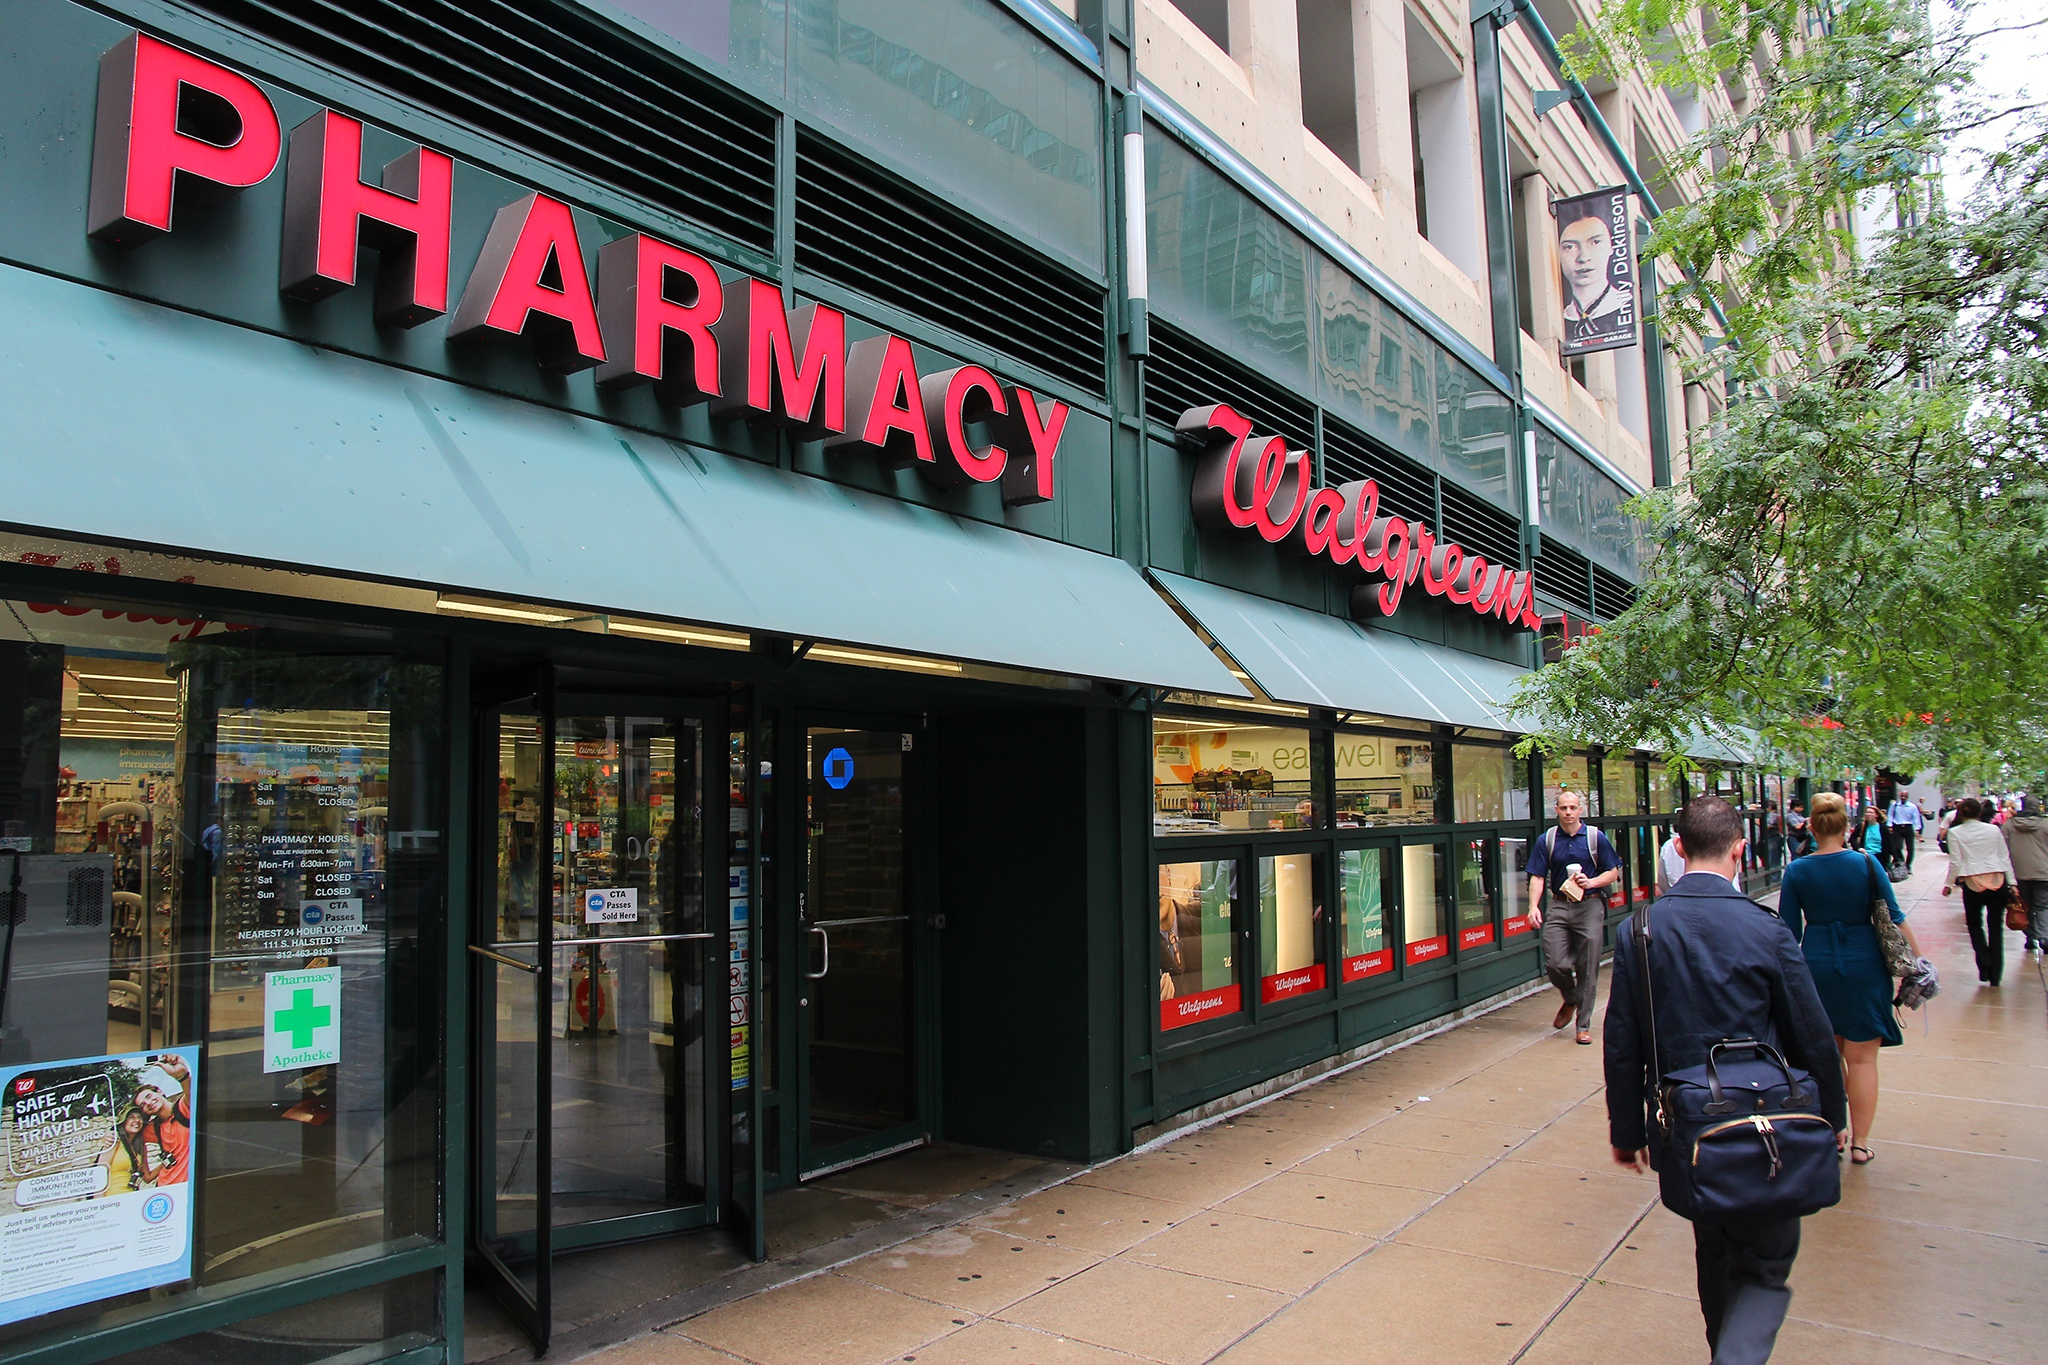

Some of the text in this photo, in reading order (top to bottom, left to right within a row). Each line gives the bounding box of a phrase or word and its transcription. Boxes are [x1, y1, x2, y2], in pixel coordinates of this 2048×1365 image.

[1611, 193, 1633, 326] Emily Dickinson
[122, 30, 1070, 503] PHARMACY
[1603, 333, 1633, 343] GARAGE
[1203, 402, 1542, 632] Walgreens
[119, 748, 167, 759] pharmacy
[275, 744, 342, 754] STORE HOURS
[119, 760, 175, 769] immunizatio
[1273, 747, 1309, 770] ea
[257, 782, 355, 794] Sat 8am-5pm
[257, 797, 354, 807] Sun CLOSED
[262, 834, 350, 844] PHARMACY HOURS
[258, 860, 352, 870] Mon-Fri 6:30am-7pm
[257, 873, 351, 884] Sat CLOSED
[257, 888, 351, 899] Sun CLOSED
[609, 890, 626, 899] CTA
[329, 901, 349, 910] CTA
[590, 899, 604, 907] cta
[606, 901, 631, 910] Passes
[325, 913, 355, 922] Passes
[602, 911, 636, 920] Sold Here
[238, 923, 368, 940] NEAREST 24 HOUR LOCATION
[1465, 930, 1486, 943] Walgreens
[263, 936, 346, 949] 111 S. HALSTED ST
[1414, 943, 1439, 956] Walgreens
[1353, 957, 1381, 972] Walgreens
[271, 973, 335, 986] Pharmacy
[1275, 974, 1311, 991] Walgreens
[1178, 996, 1223, 1016] Walgreens
[271, 1050, 333, 1067] Apotheke
[16, 1086, 87, 1114] SAFE and
[17, 1104, 72, 1130] HAPPY
[19, 1116, 90, 1145] TRAVELS
[22, 1129, 105, 1159] VIAJES SEGUROS
[35, 1147, 76, 1166] FELICES
[30, 1172, 87, 1186] CONSULTATION
[31, 1177, 94, 1193] IMMUNIZATIONS
[27, 1190, 61, 1202] CONSULTAS
[70, 1185, 97, 1195] VACUNAS
[5, 1201, 121, 1229] Just tell us where you're going
[4, 1227, 20, 1236] and
[21, 1223, 41, 1234] we'll
[42, 1219, 67, 1231] advise
[68, 1217, 82, 1227] you
